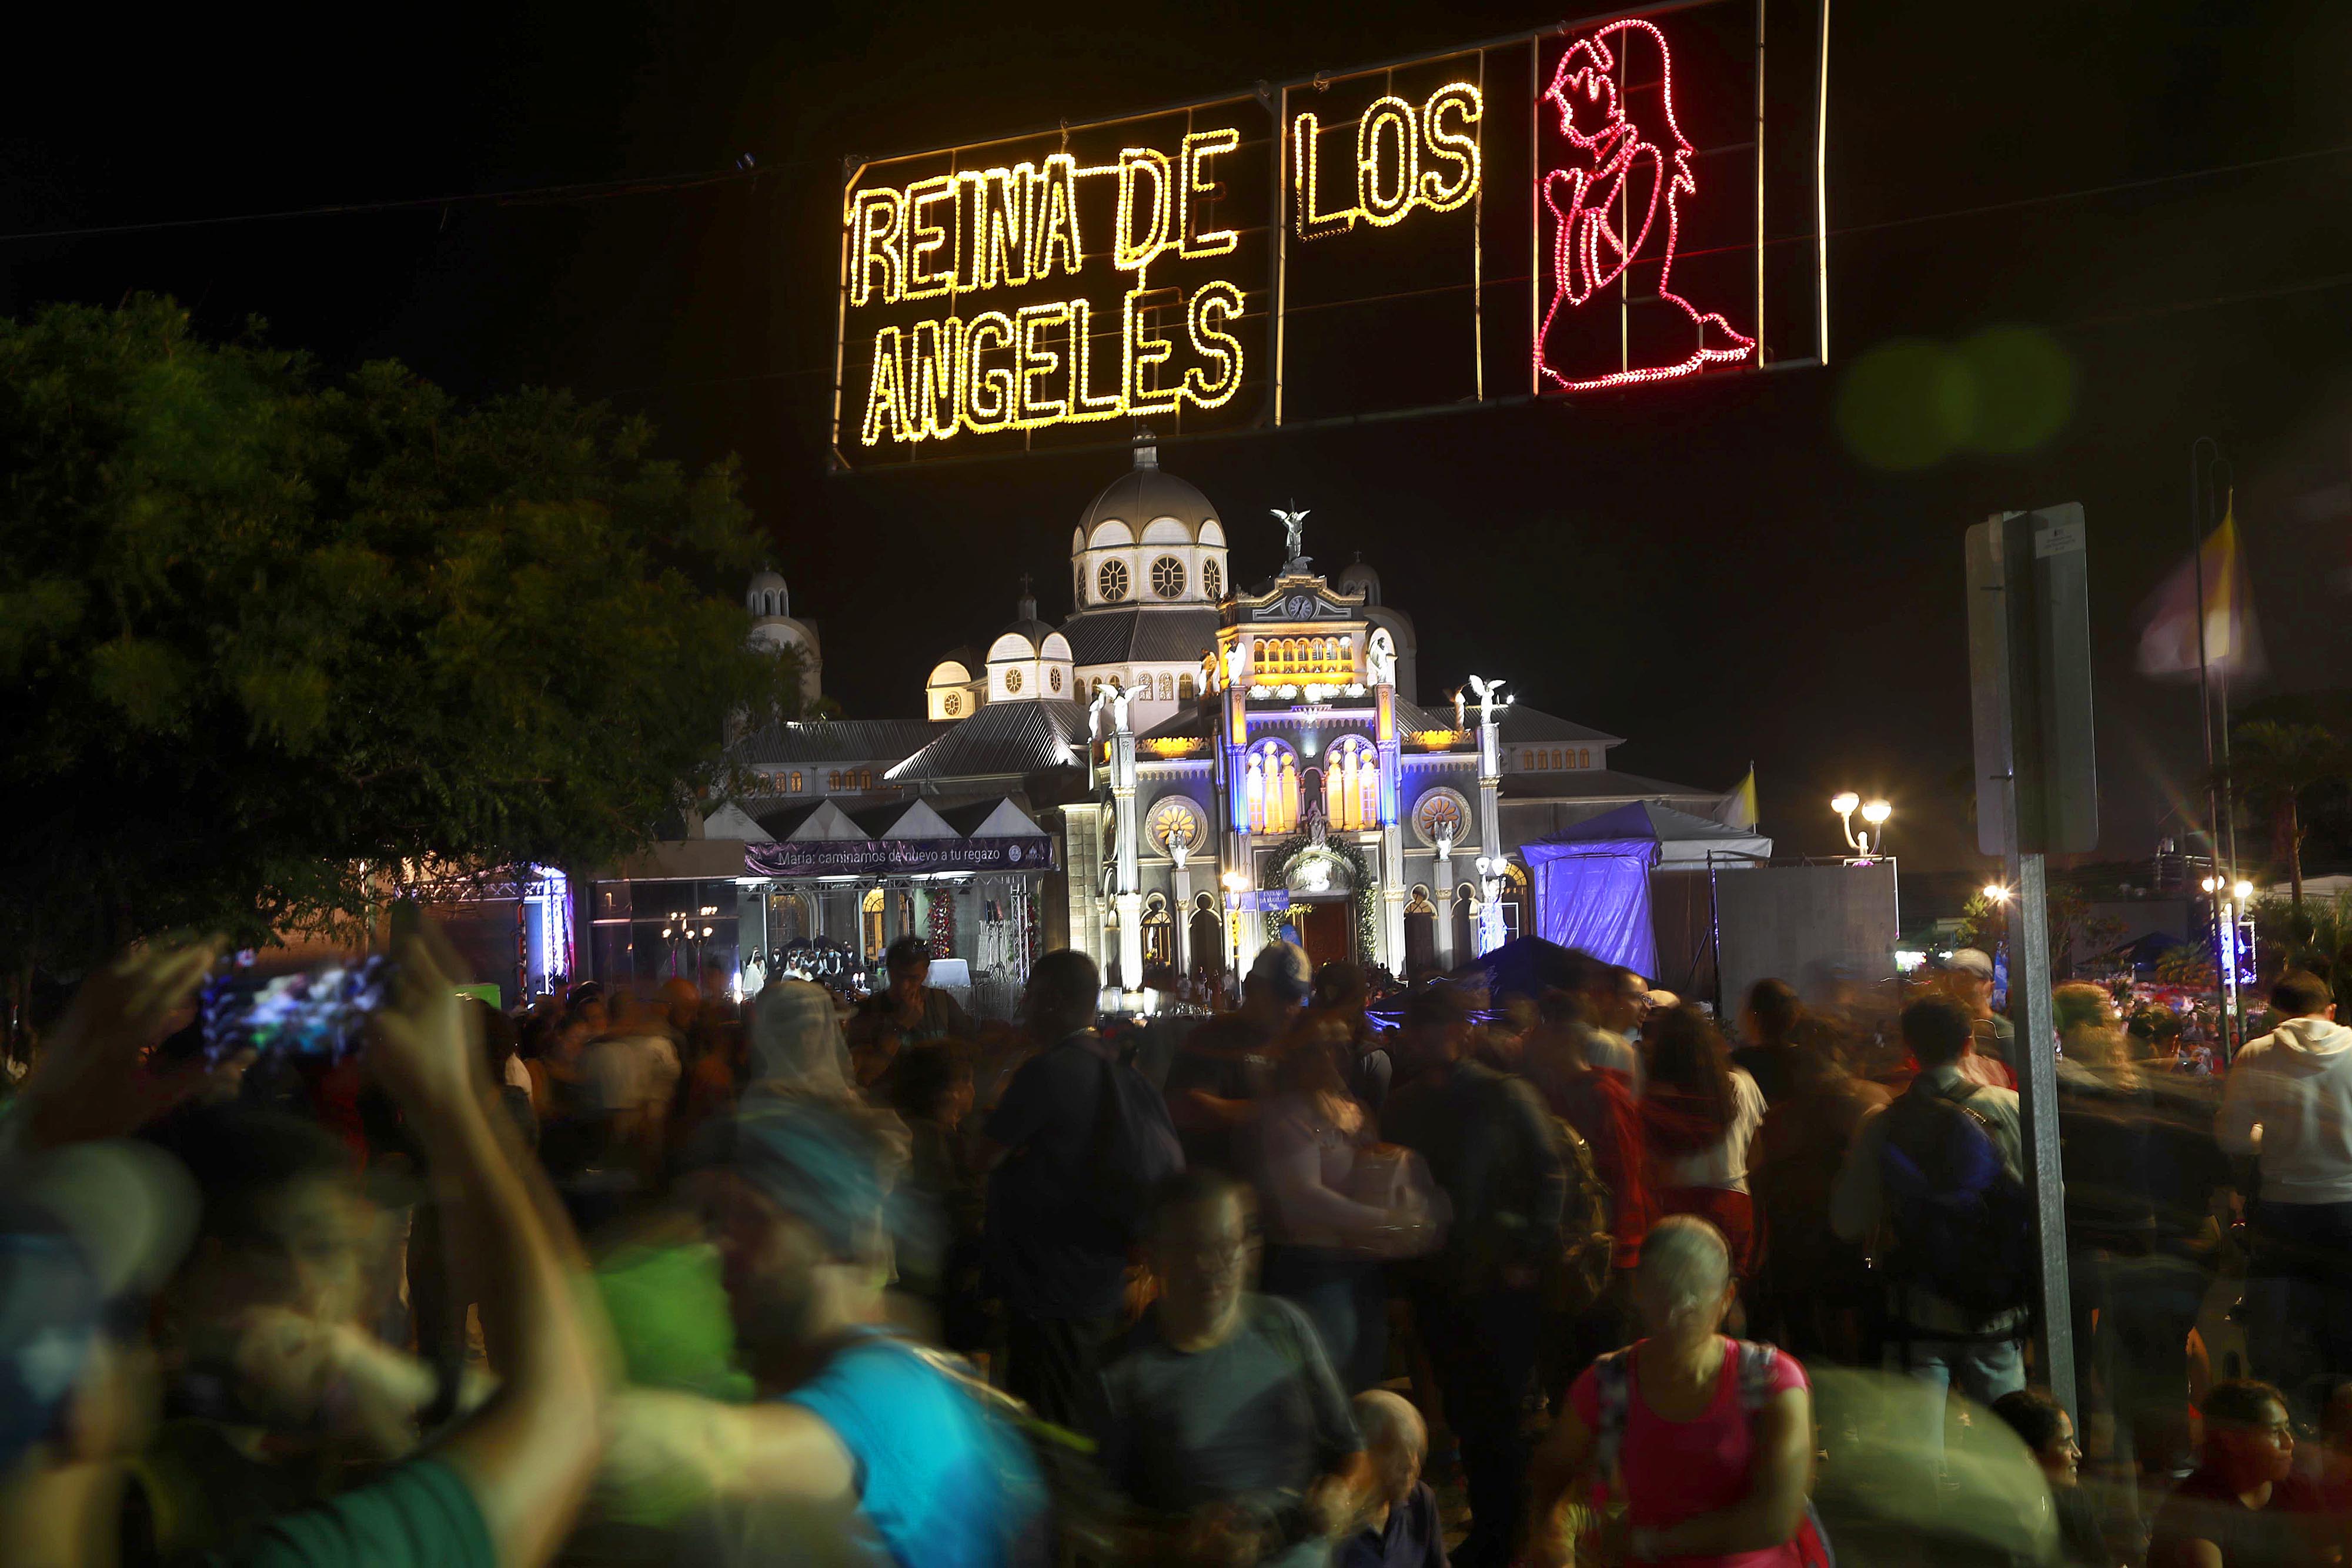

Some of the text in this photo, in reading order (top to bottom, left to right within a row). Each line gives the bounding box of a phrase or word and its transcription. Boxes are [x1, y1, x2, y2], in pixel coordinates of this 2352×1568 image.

[850, 81, 1483, 307] REINA DE LOS
[861, 280, 1245, 446] ANGELES
[777, 848, 1000, 865] María: caminamos de nuevo a tu regazo
